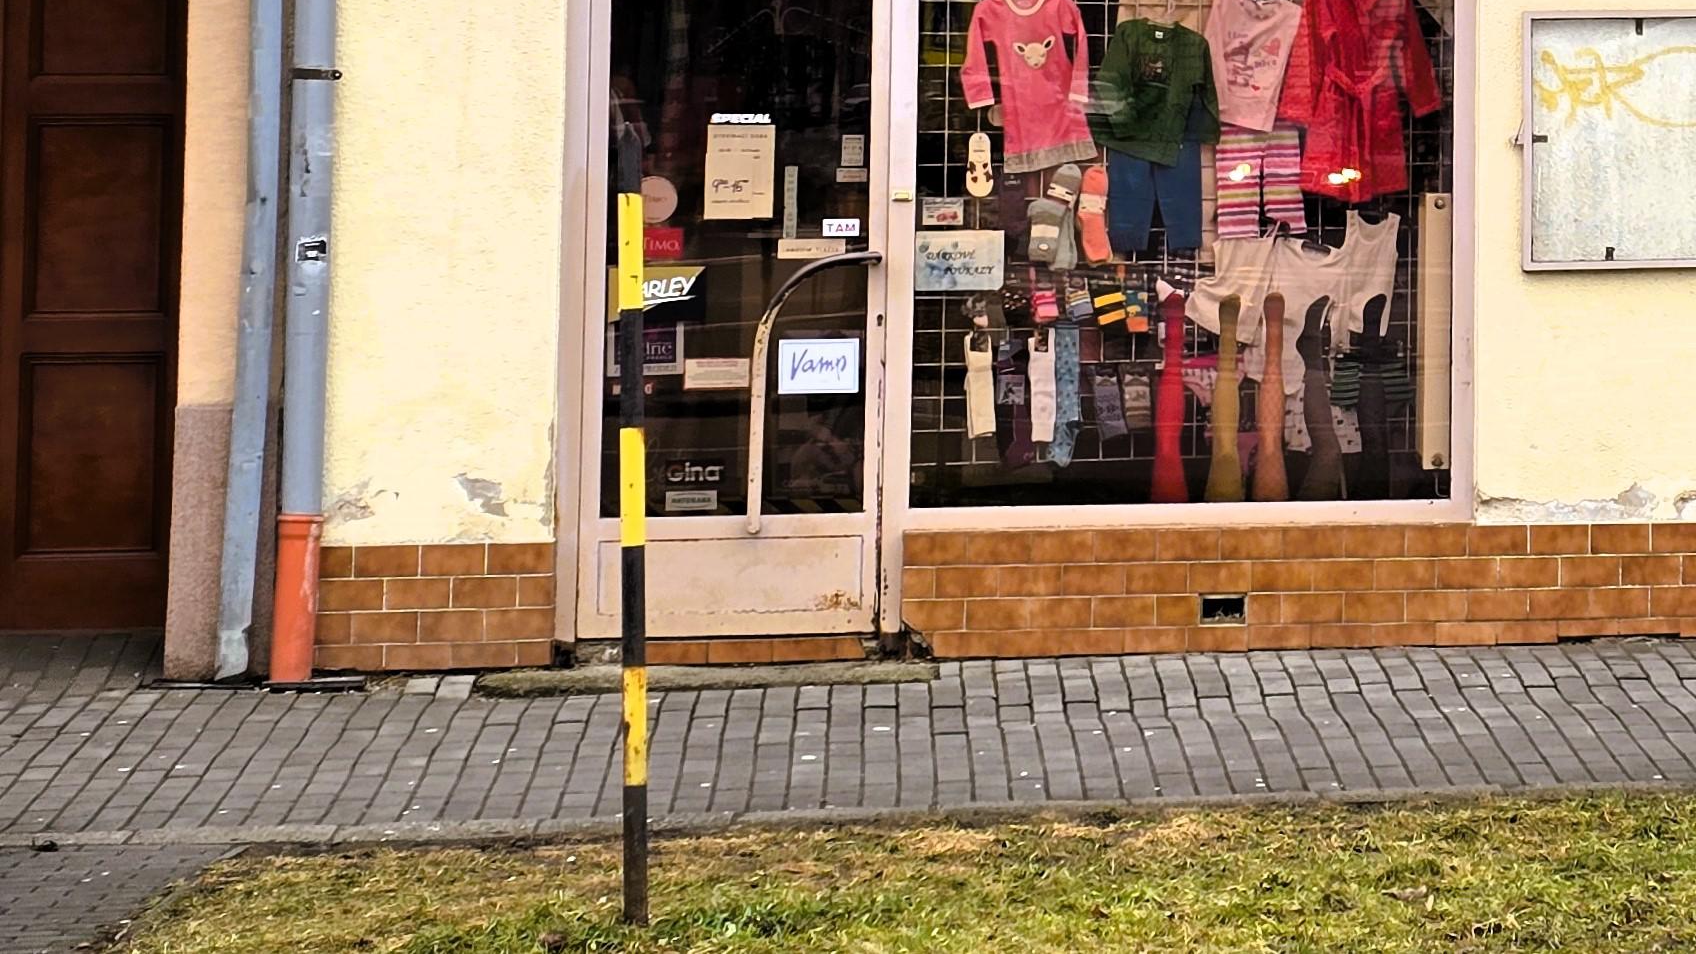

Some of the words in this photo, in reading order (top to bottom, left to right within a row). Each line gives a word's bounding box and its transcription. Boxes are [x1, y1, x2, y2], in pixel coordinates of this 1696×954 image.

[642, 276, 696, 298] ARLEY
[790, 349, 847, 382] Vamp
[667, 462, 724, 482] Gina
